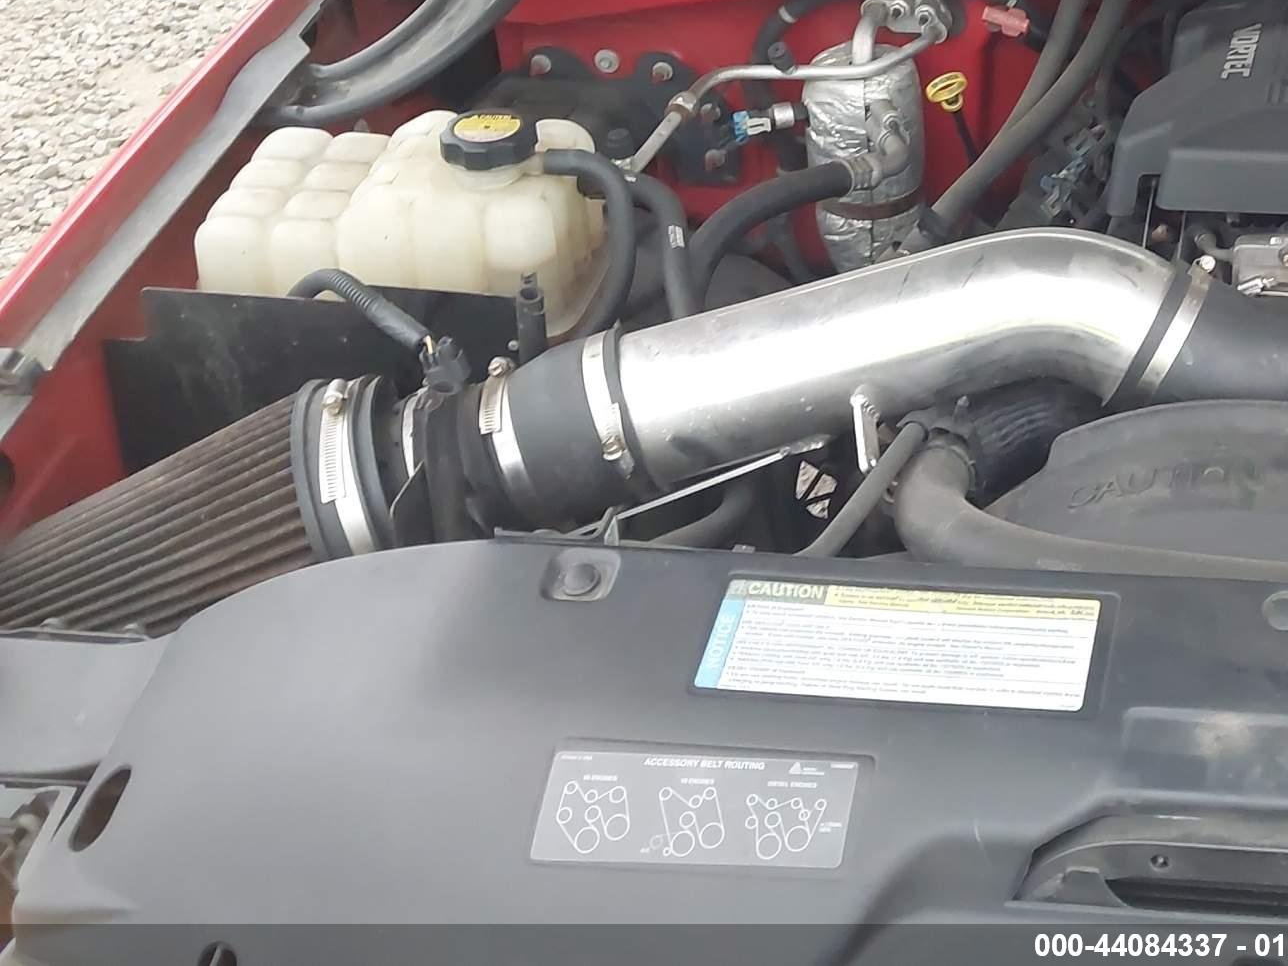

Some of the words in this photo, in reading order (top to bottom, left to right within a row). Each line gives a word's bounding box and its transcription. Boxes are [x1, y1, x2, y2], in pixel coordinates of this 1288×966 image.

[1221, 23, 1262, 79] VORTEC
[749, 581, 825, 600] CAUTION
[643, 757, 700, 769] ACCESSORY
[700, 760, 723, 769] BELT
[724, 761, 766, 771] ROUTING
